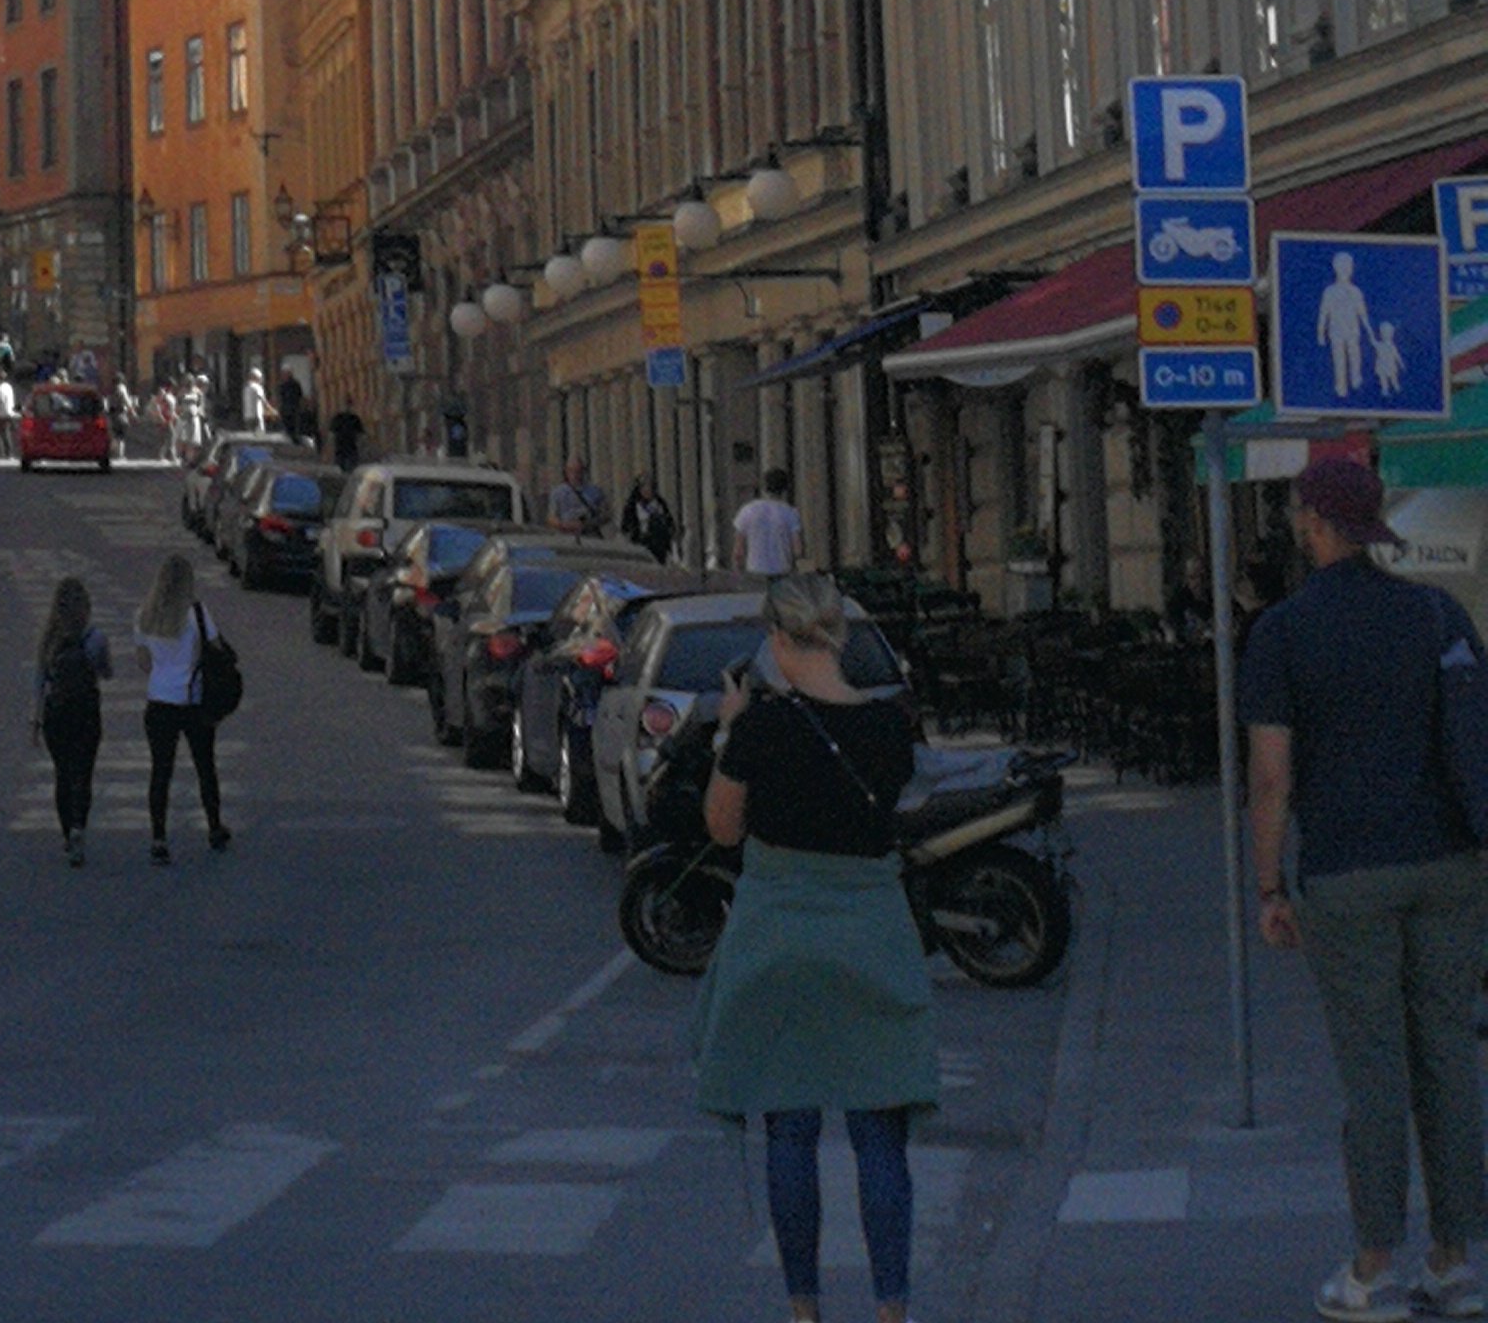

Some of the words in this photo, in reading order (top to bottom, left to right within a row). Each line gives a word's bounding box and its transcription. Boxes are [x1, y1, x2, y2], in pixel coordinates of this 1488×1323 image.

[1160, 87, 1228, 181] P
[1154, 364, 1215, 388] 0-10
[1224, 368, 1246, 386] m
